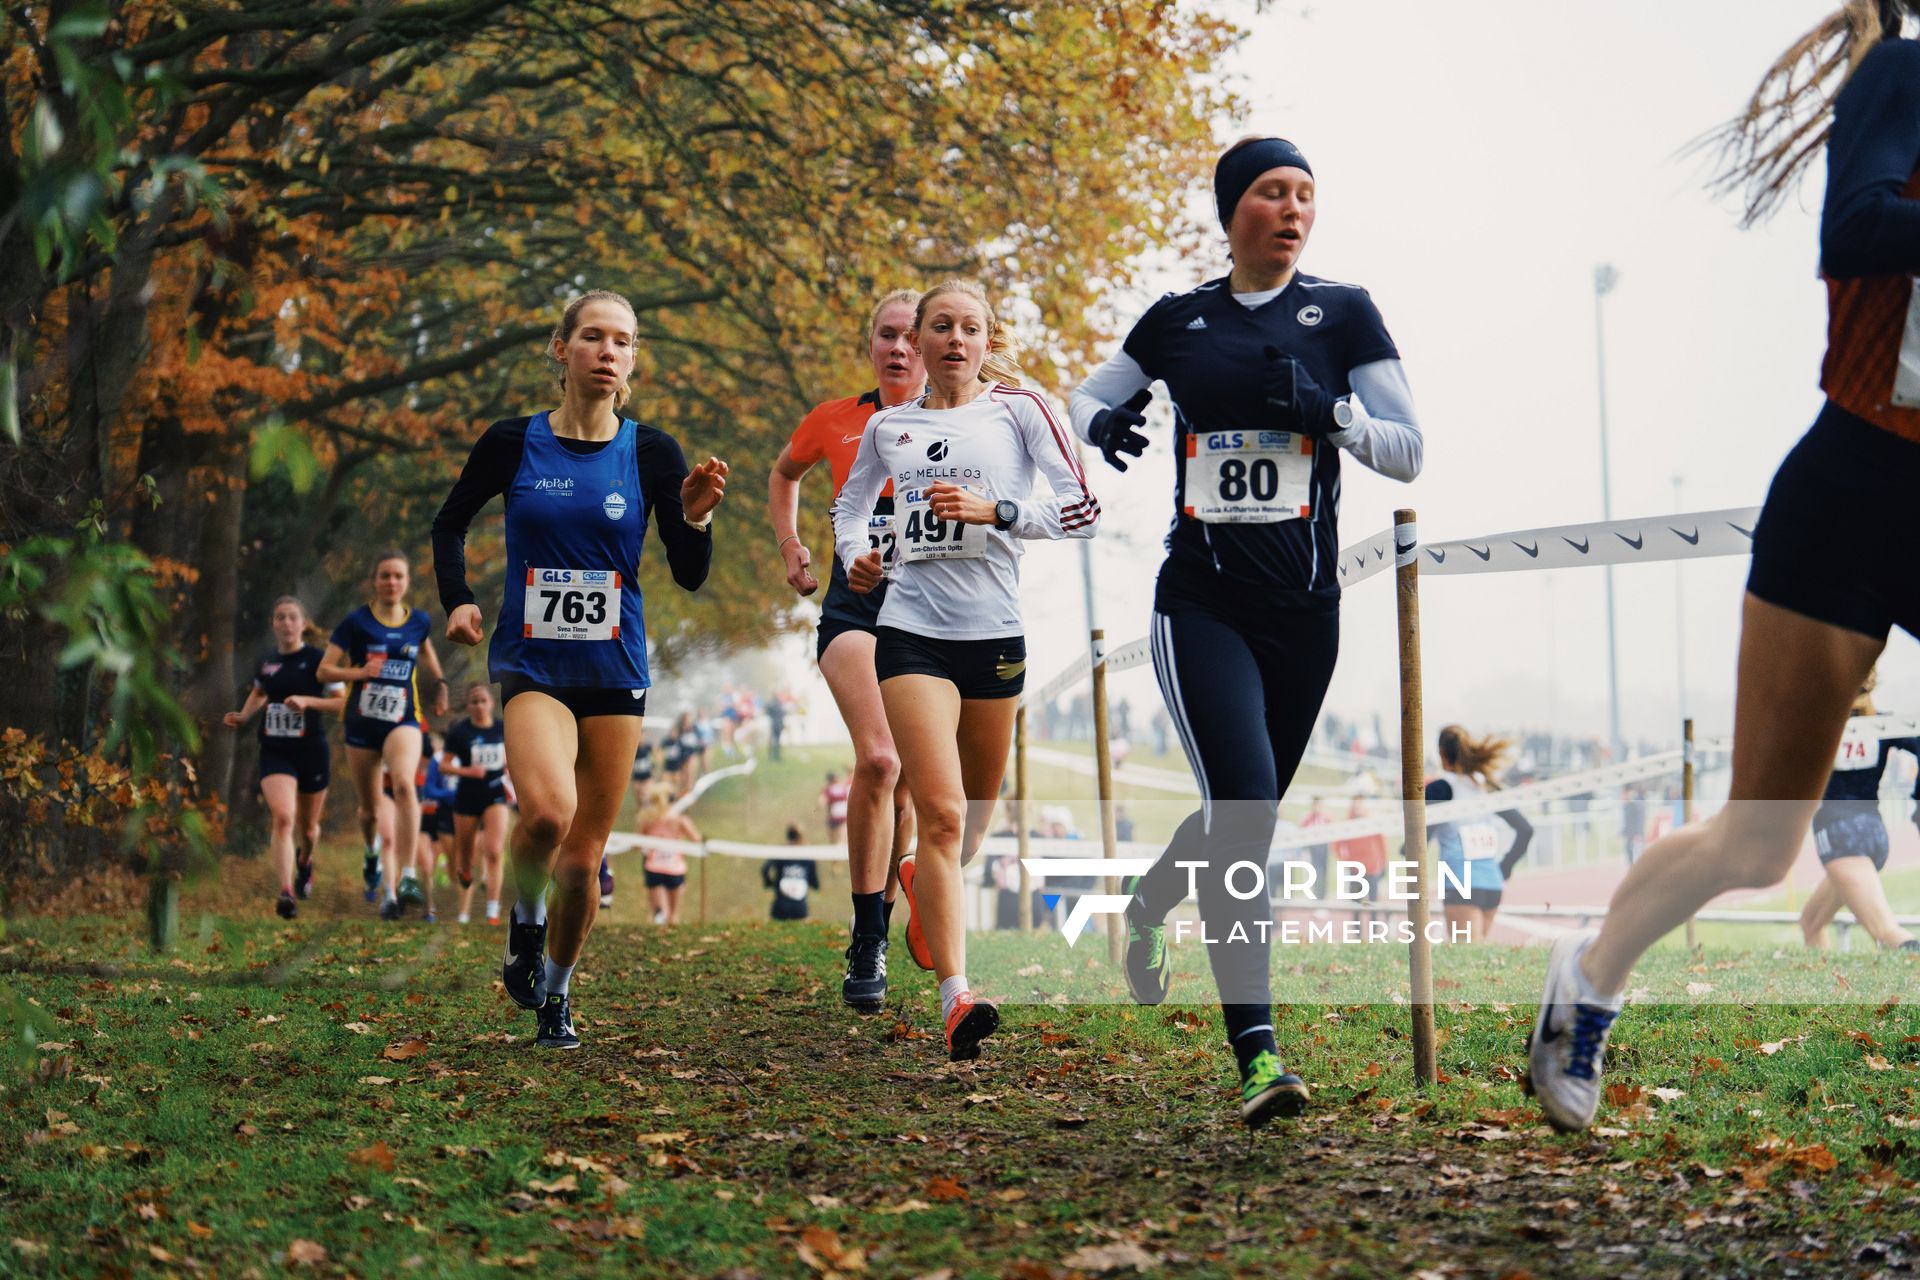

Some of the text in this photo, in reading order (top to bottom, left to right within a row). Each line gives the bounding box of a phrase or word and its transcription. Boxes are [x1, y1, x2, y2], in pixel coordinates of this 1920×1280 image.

[899, 471, 911, 483] SC
[917, 468, 958, 478] MELLE
[1218, 458, 1279, 502] 80
[947, 544, 964, 552] Opitz
[540, 590, 607, 625] 763
[367, 693, 398, 713] 747
